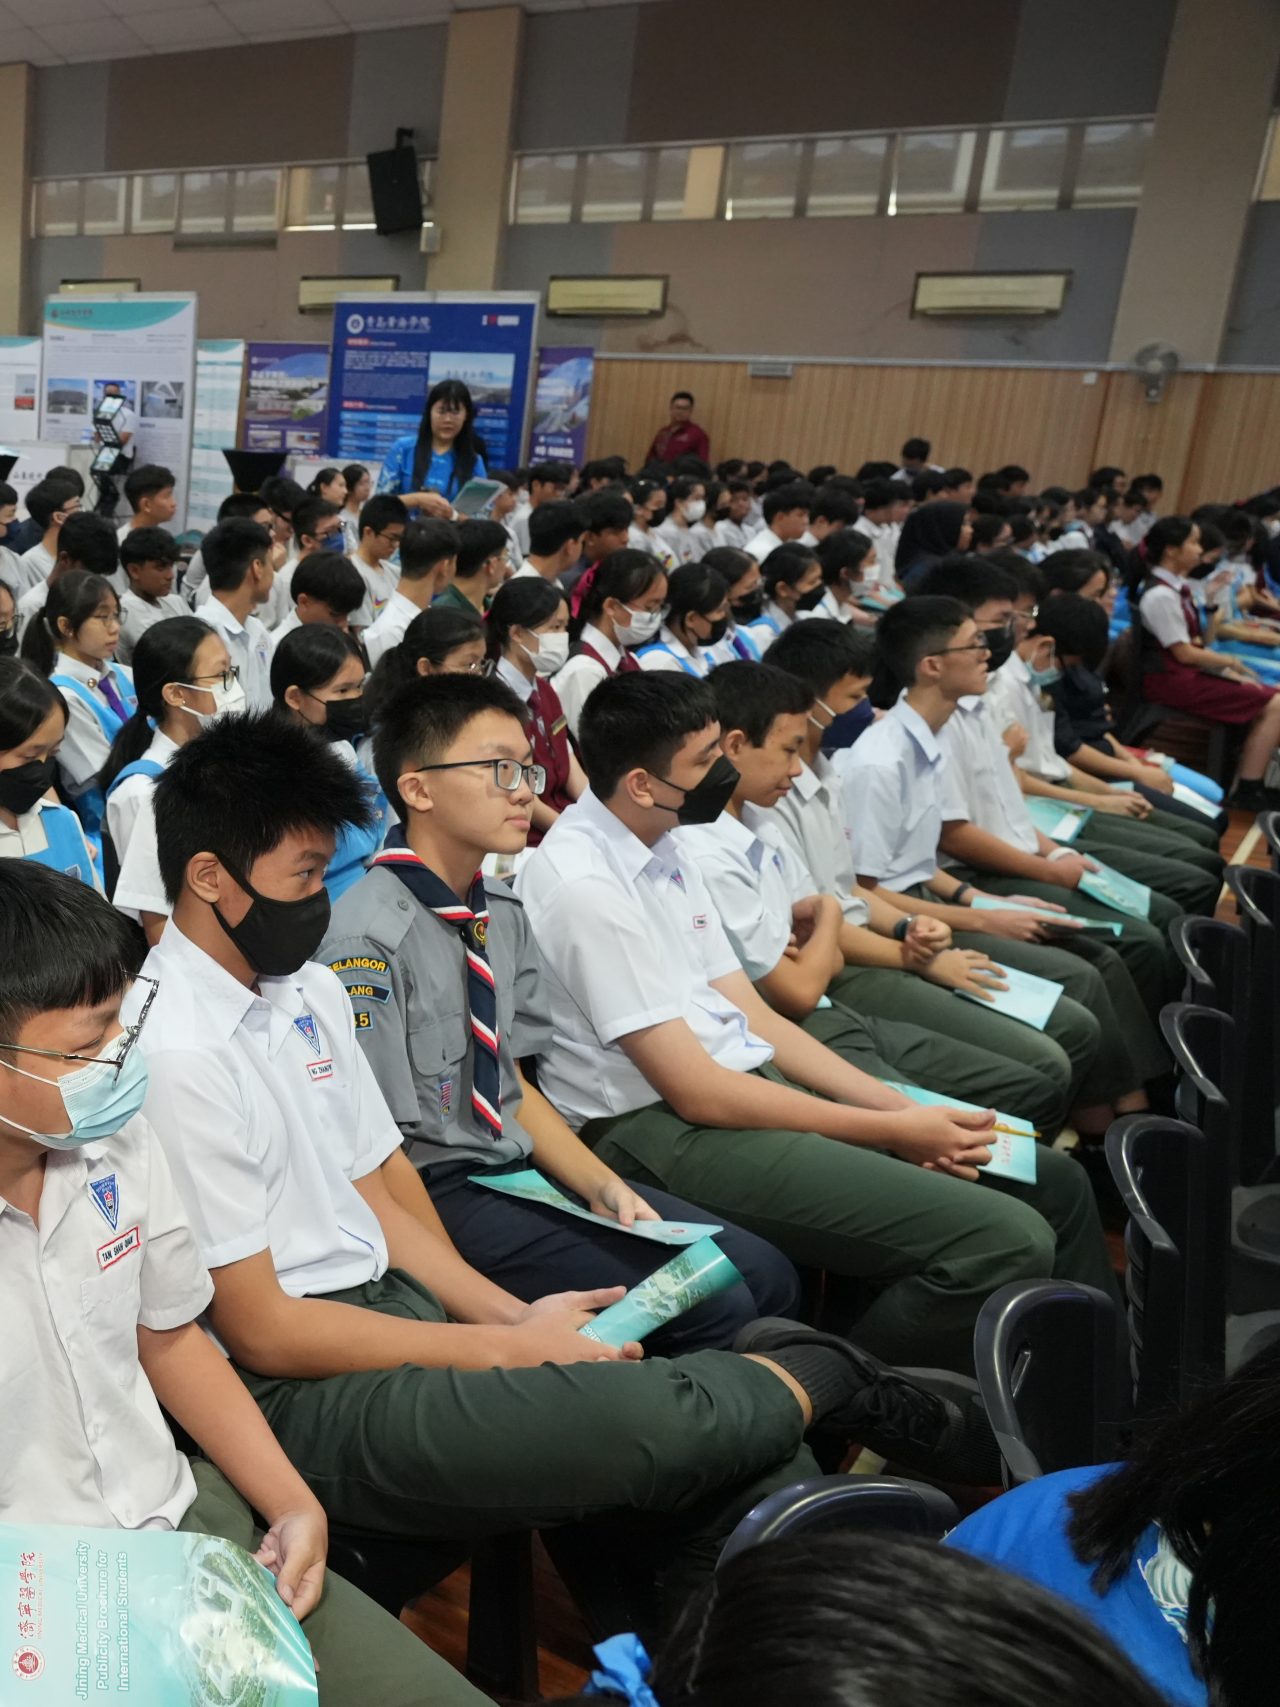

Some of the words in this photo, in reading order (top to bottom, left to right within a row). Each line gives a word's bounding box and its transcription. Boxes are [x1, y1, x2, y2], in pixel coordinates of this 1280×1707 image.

[76, 1541, 90, 1602] University
[96, 1550, 108, 1568] for
[116, 1552, 128, 1606] Students
[96, 1571, 109, 1628] Brochure
[76, 1606, 89, 1655] Medical
[117, 1609, 129, 1691] International
[76, 1658, 90, 1700] Jining
[96, 1632, 110, 1690] Publicity
